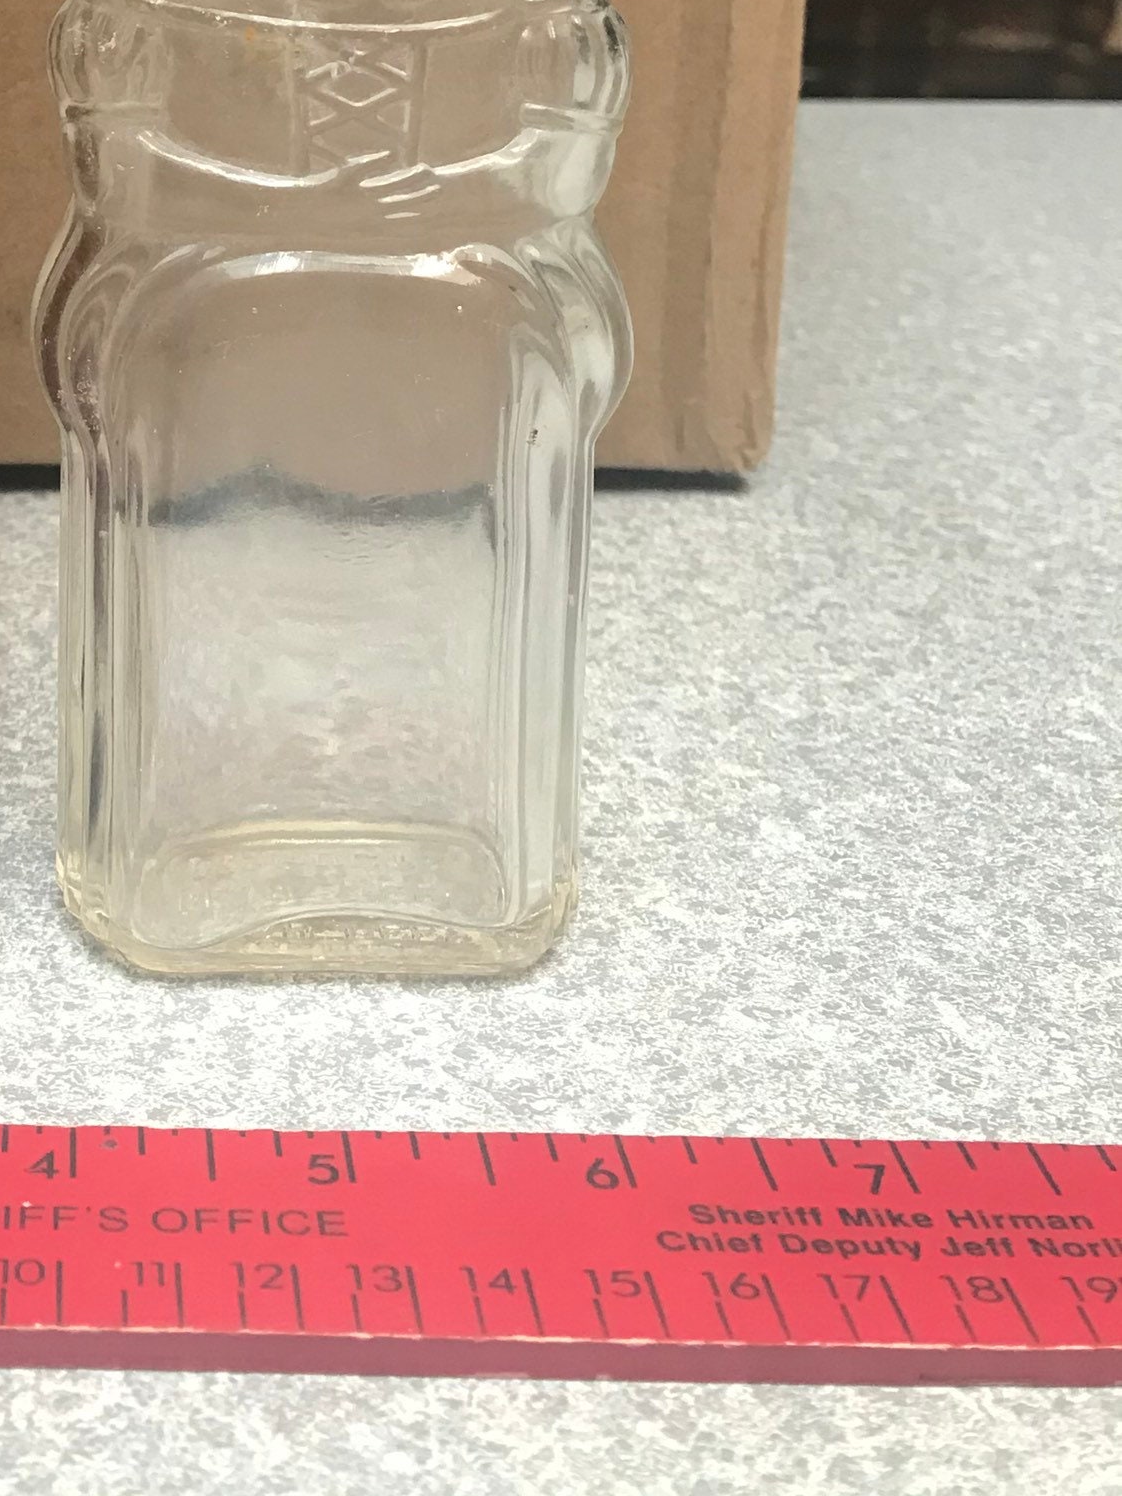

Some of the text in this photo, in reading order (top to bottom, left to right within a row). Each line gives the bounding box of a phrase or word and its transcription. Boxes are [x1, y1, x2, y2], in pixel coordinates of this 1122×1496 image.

[25, 1150, 60, 1179] 4
[308, 1153, 340, 1185] 5
[585, 1157, 620, 1190] 6
[853, 1163, 886, 1195] 7
[151, 1207, 349, 1238] OFFICE
[687, 1203, 1095, 1231] Sheriff Mike Hirman
[656, 1229, 765, 1254] Chief
[780, 1232, 923, 1261] Deputy
[940, 1236, 1017, 1259] Jeff
[129, 1260, 166, 1288] 11
[230, 1260, 284, 1291] 12
[346, 1262, 404, 1292] 13
[460, 1265, 518, 1293] 14
[584, 1268, 641, 1298] 15
[702, 1270, 761, 1300] 16
[817, 1272, 871, 1301] 17
[939, 1274, 1006, 1303] 18
[1060, 1275, 1119, 1304] 19
